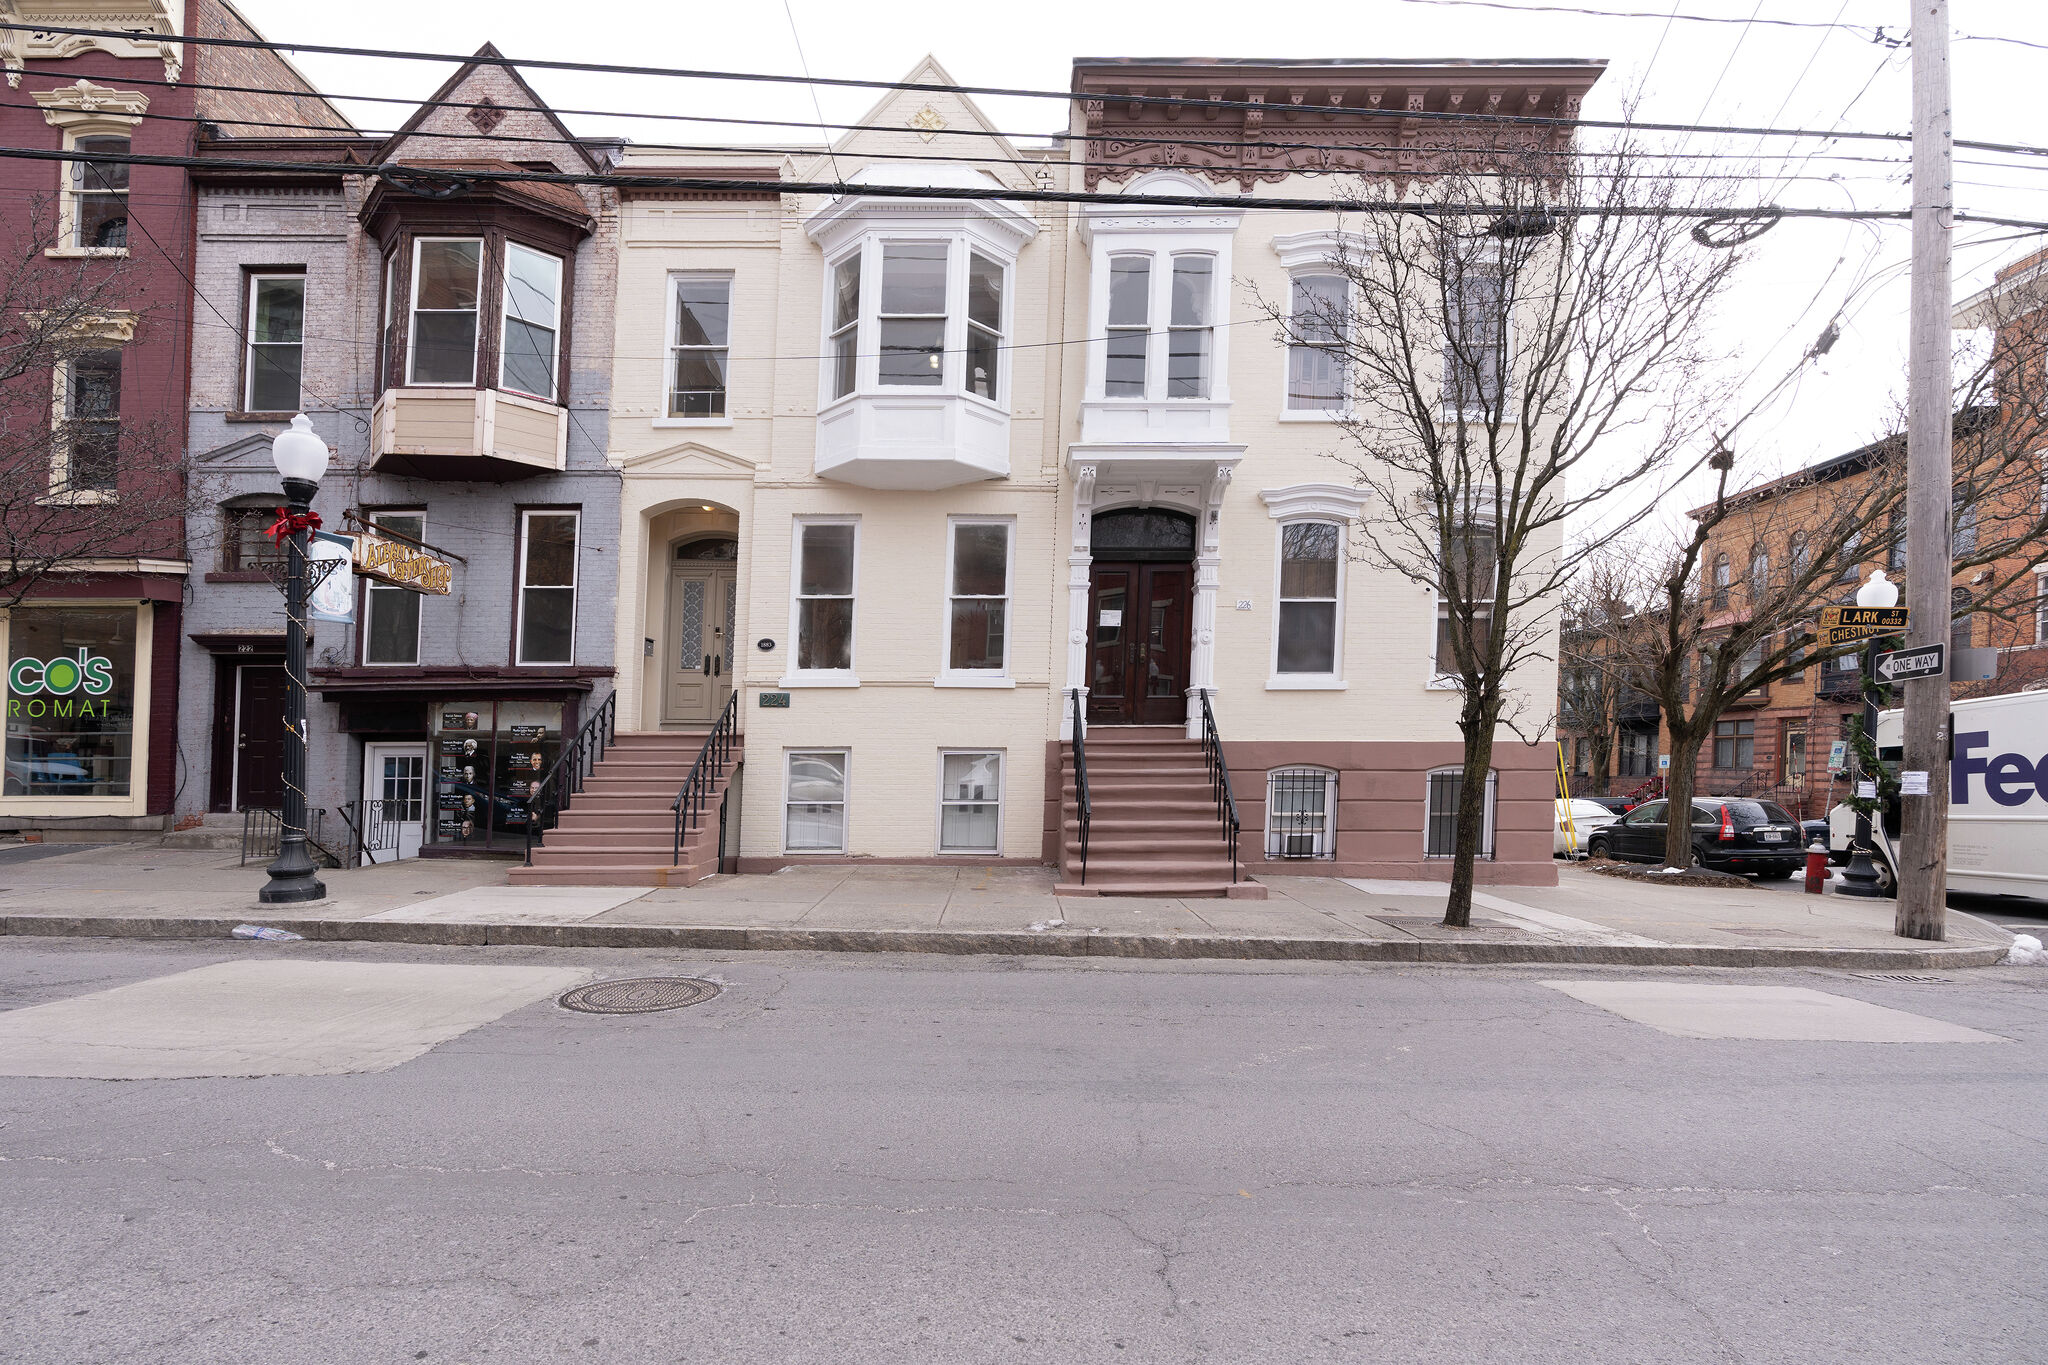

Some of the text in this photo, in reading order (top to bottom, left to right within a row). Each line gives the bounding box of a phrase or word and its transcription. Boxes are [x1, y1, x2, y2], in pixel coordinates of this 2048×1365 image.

[365, 542, 415, 569] ALBANY
[388, 556, 452, 595] COFFEE SHOP
[1238, 600, 1251, 609] 226
[1842, 611, 1879, 623] LARK
[1881, 617, 1902, 625] 00332
[8, 647, 113, 695] CO'S
[1893, 658, 1911, 672] ONE
[1915, 654, 1936, 669] WAY
[7, 699, 111, 718] ROMAT
[762, 693, 786, 706] 224
[1950, 730, 2048, 807] Fe
